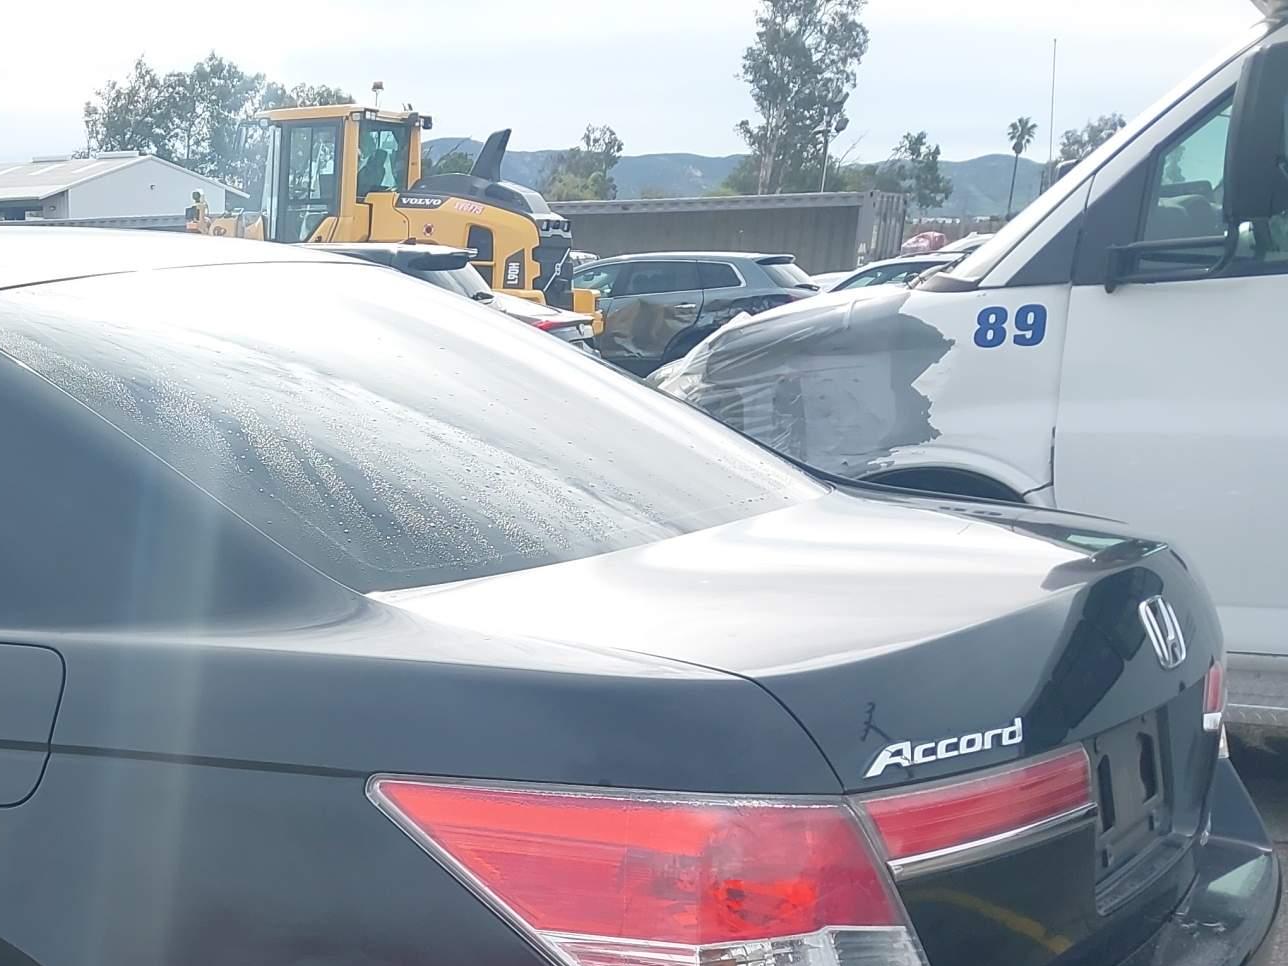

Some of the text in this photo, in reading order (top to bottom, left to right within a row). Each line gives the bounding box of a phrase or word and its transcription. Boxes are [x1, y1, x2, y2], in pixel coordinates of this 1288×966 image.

[401, 197, 442, 206] VOLVO
[506, 262, 521, 285] L90H
[972, 302, 1048, 348] 89
[863, 716, 1024, 780] Accord
